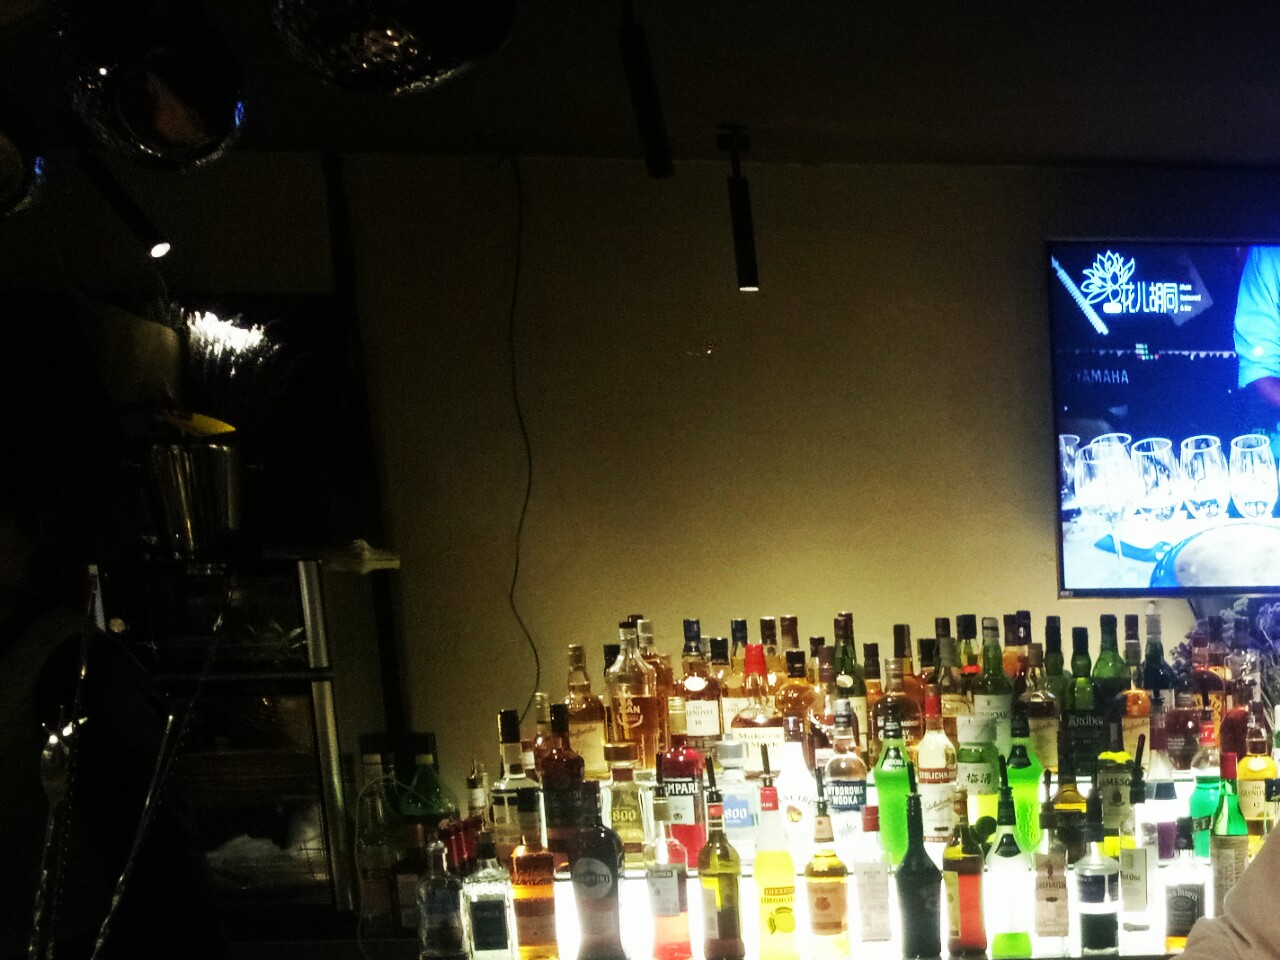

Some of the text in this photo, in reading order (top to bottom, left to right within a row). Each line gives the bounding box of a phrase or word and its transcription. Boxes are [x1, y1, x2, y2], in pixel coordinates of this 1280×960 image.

[1120, 281, 1179, 313] 花儿胡同
[1076, 368, 1129, 384] YAMAHA
[622, 705, 641, 714] AN
[966, 772, 992, 784] 梅酒
[665, 783, 699, 794] MPARI
[832, 795, 859, 805] WODKA
